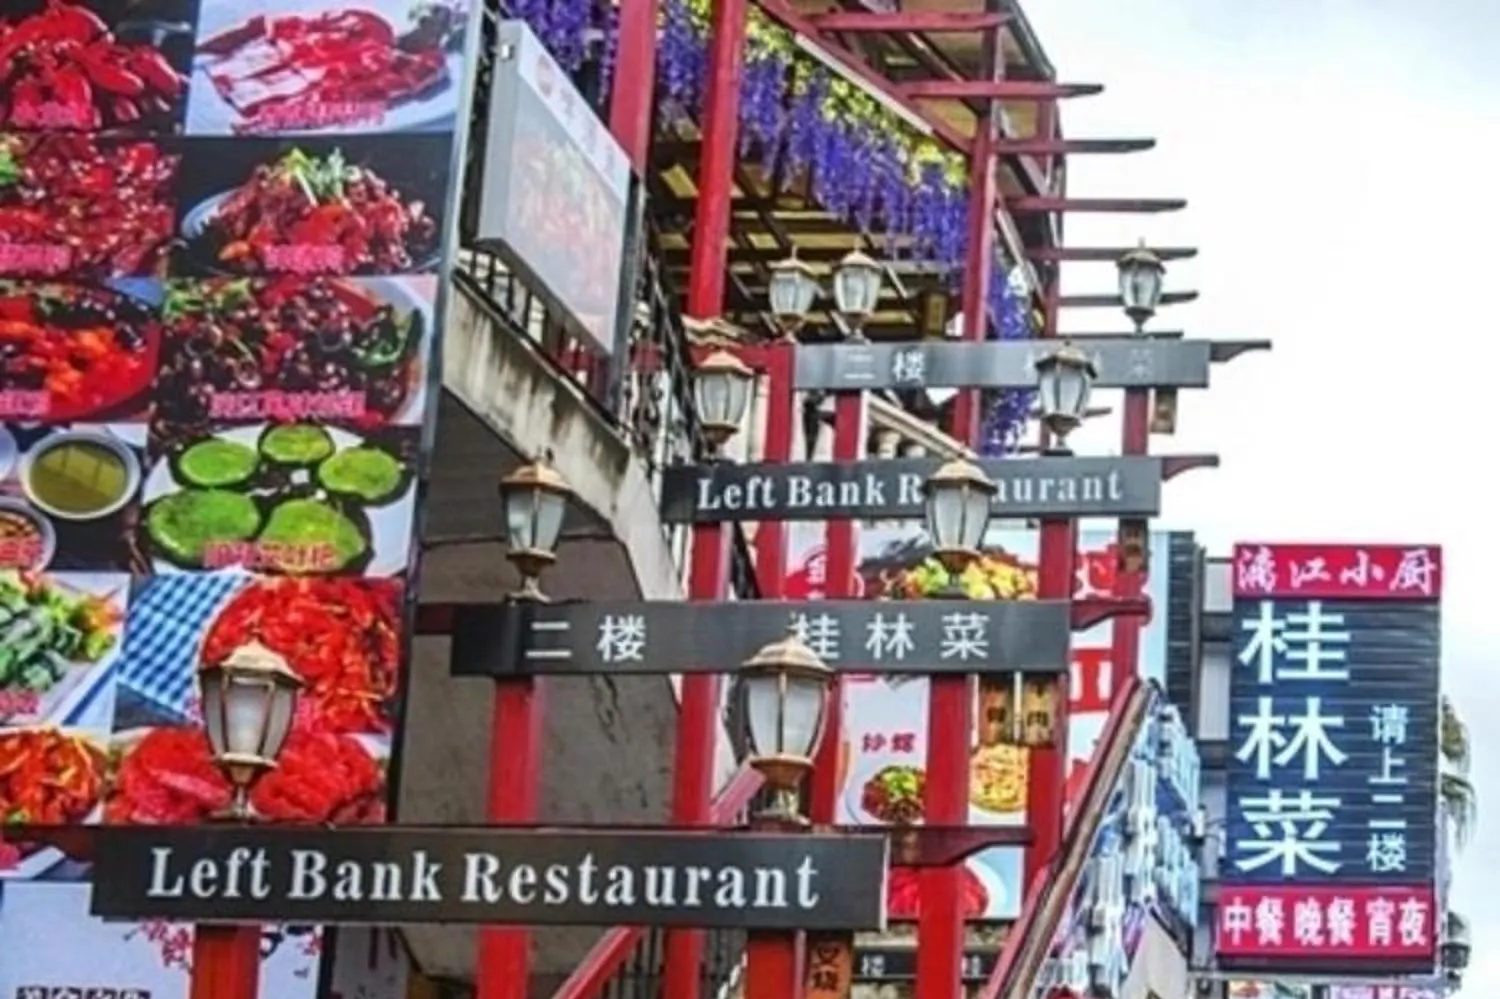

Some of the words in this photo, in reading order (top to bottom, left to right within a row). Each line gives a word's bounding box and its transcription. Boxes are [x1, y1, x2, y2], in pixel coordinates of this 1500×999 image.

[842, 352, 923, 382] 二楼
[698, 478, 776, 514] Left
[788, 473, 886, 506] Bank
[900, 468, 1122, 503] Raurant
[526, 616, 647, 662] 二楼
[792, 614, 990, 660] 桂林菜
[1236, 600, 1350, 875] 桂林菜
[1367, 704, 1408, 873] 请上二楼
[148, 847, 273, 900] Left
[289, 850, 443, 902] Bank
[460, 853, 820, 908] Restaurant
[1223, 897, 1285, 946] 中餐
[1366, 897, 1429, 946] 宵夜
